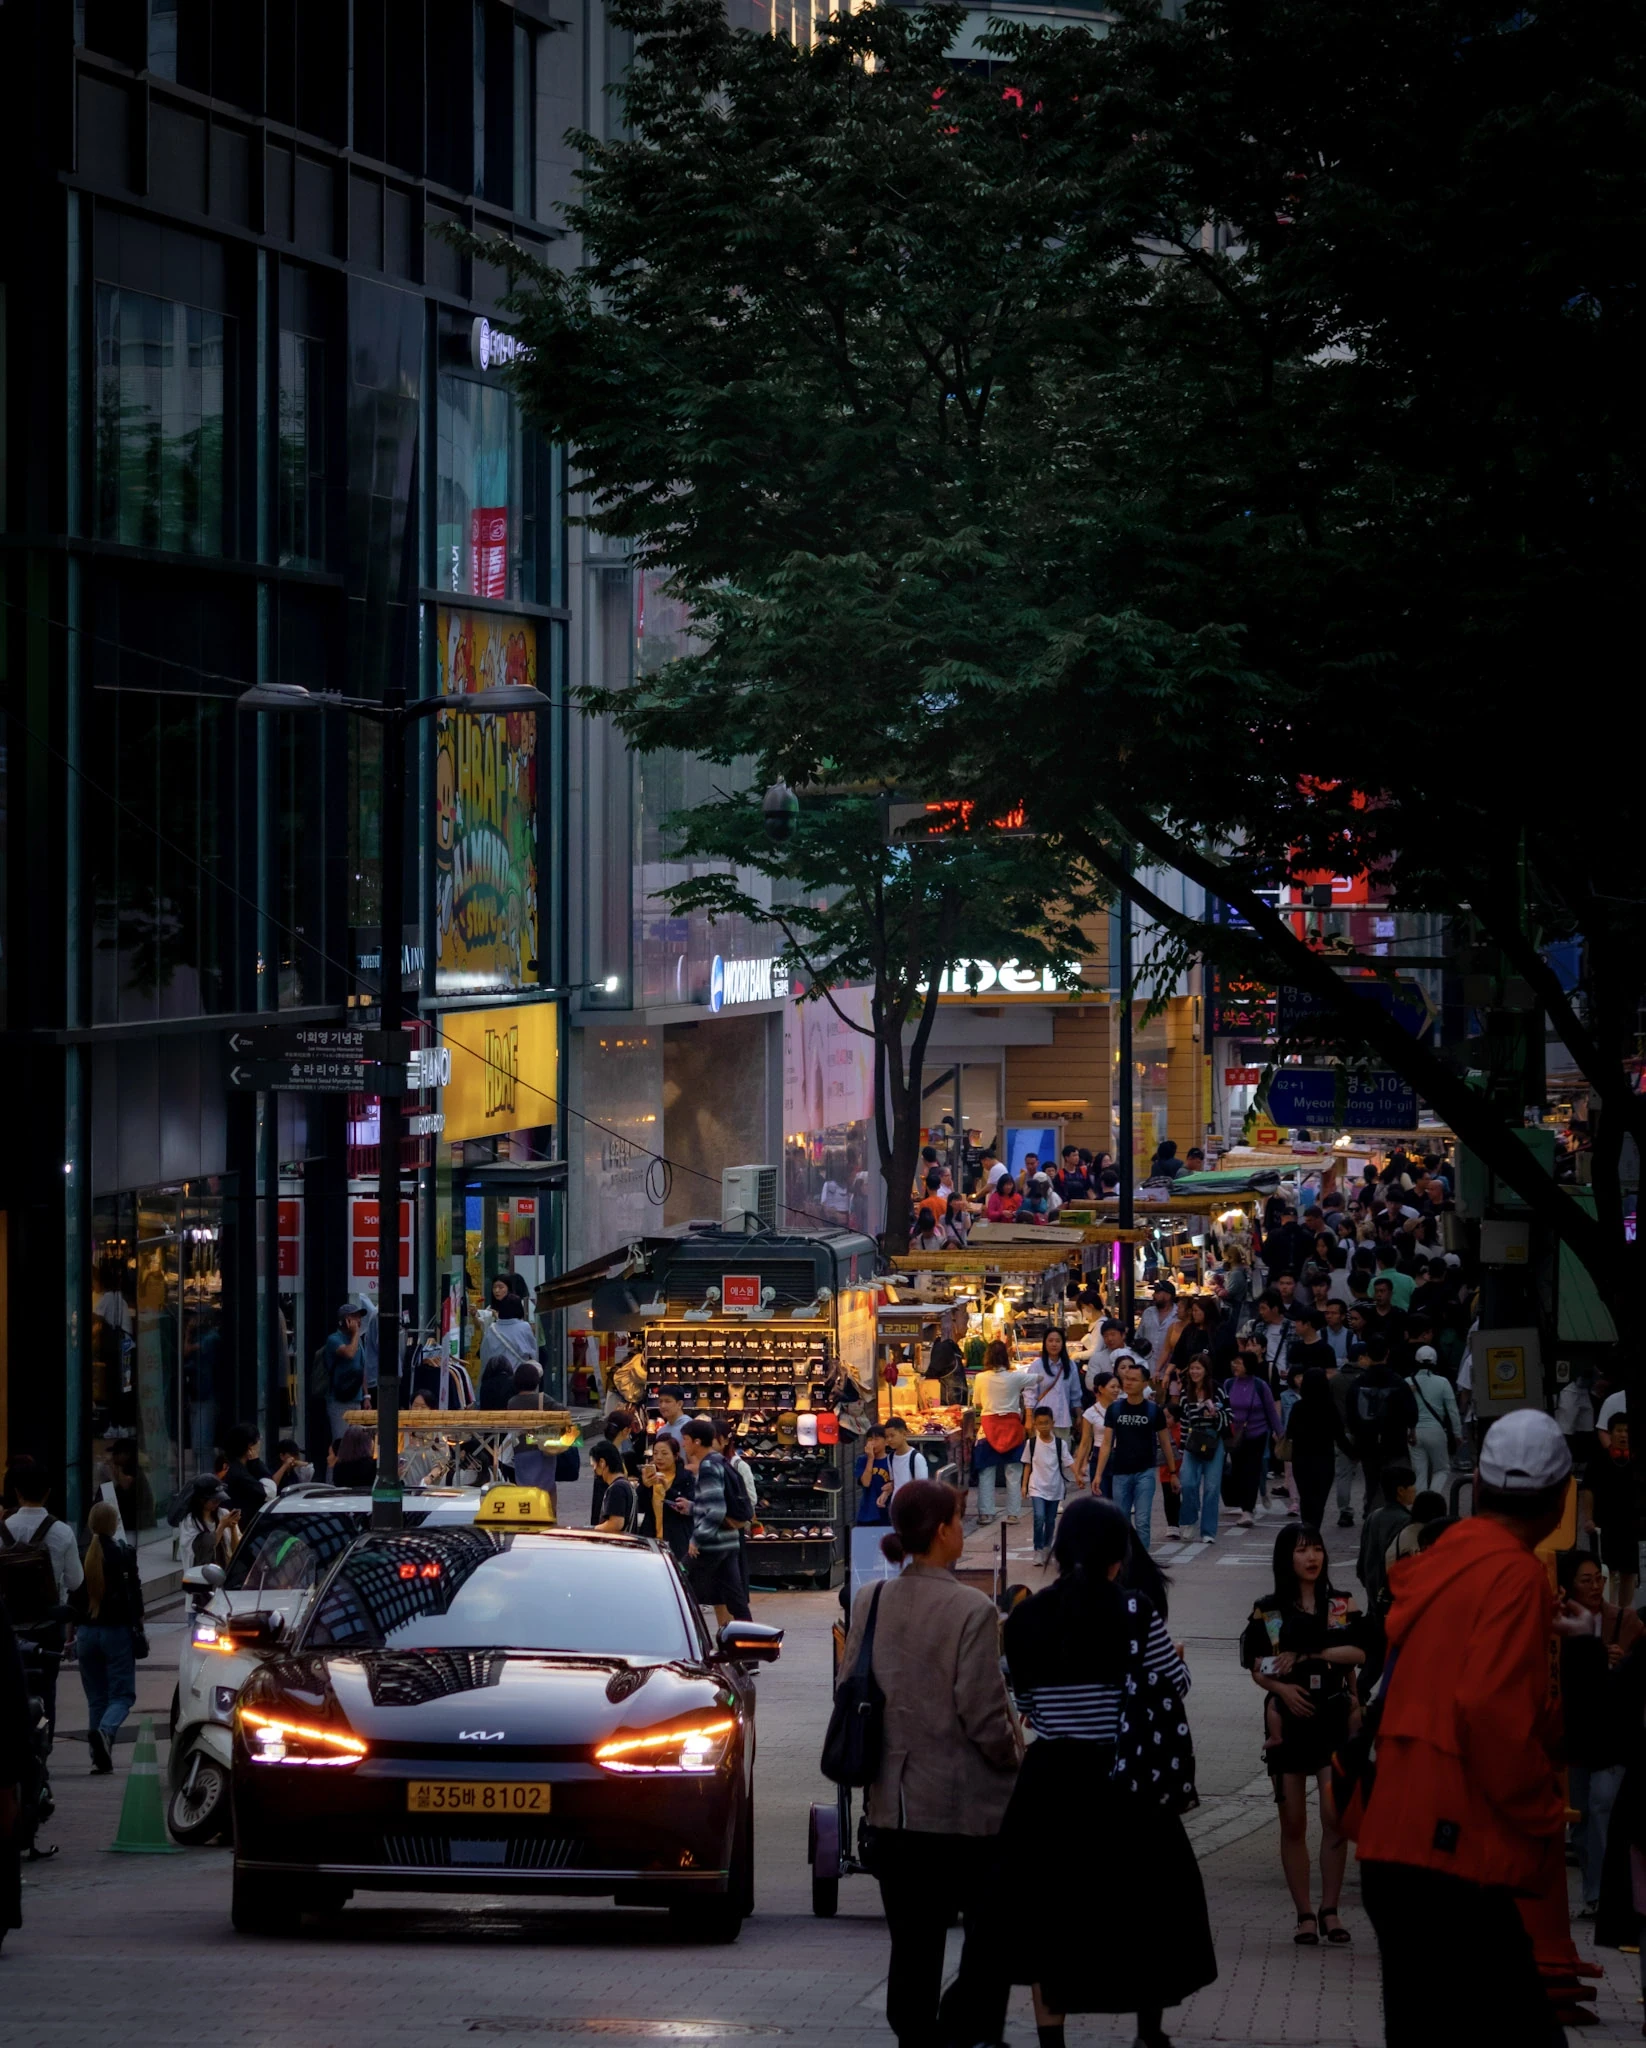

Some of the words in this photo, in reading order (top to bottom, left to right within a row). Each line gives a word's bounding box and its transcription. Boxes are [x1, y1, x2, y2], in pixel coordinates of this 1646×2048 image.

[458, 712, 508, 835] HBAF
[453, 829, 510, 896] ALMOND
[465, 892, 499, 939] store
[749, 958, 772, 1002] BANK
[296, 1031, 328, 1044] 이회영
[331, 1031, 364, 1045] 기념관
[485, 1025, 519, 1118] HBAF
[1031, 1111, 1084, 1120] EIDER
[729, 1286, 754, 1297] 에스원
[1117, 1414, 1149, 1426] KENZO
[482, 1786, 541, 1809] 8102
